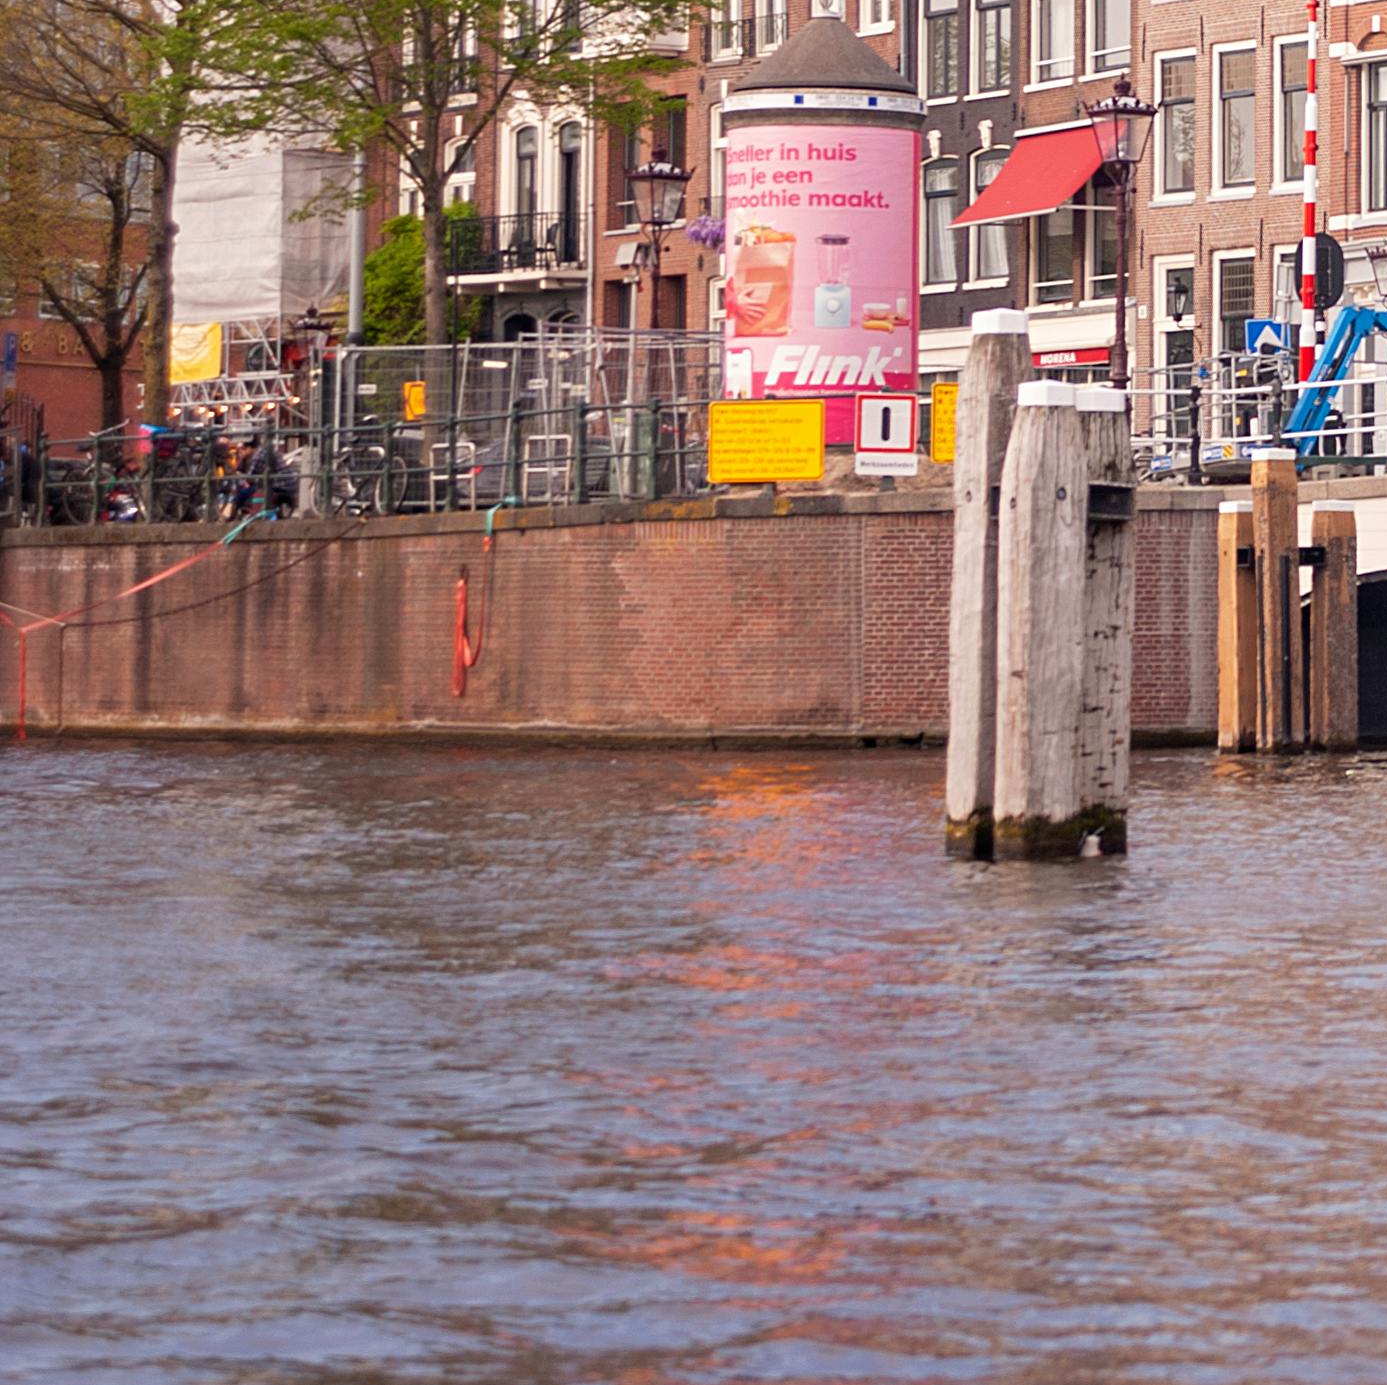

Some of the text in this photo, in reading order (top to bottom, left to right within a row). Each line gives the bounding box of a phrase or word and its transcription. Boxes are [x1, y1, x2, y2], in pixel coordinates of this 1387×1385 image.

[780, 143, 799, 160] in
[807, 143, 857, 162] huis
[751, 167, 766, 190] je
[772, 169, 813, 185] een
[807, 190, 890, 209] maakt.
[764, 344, 893, 386] Flink
